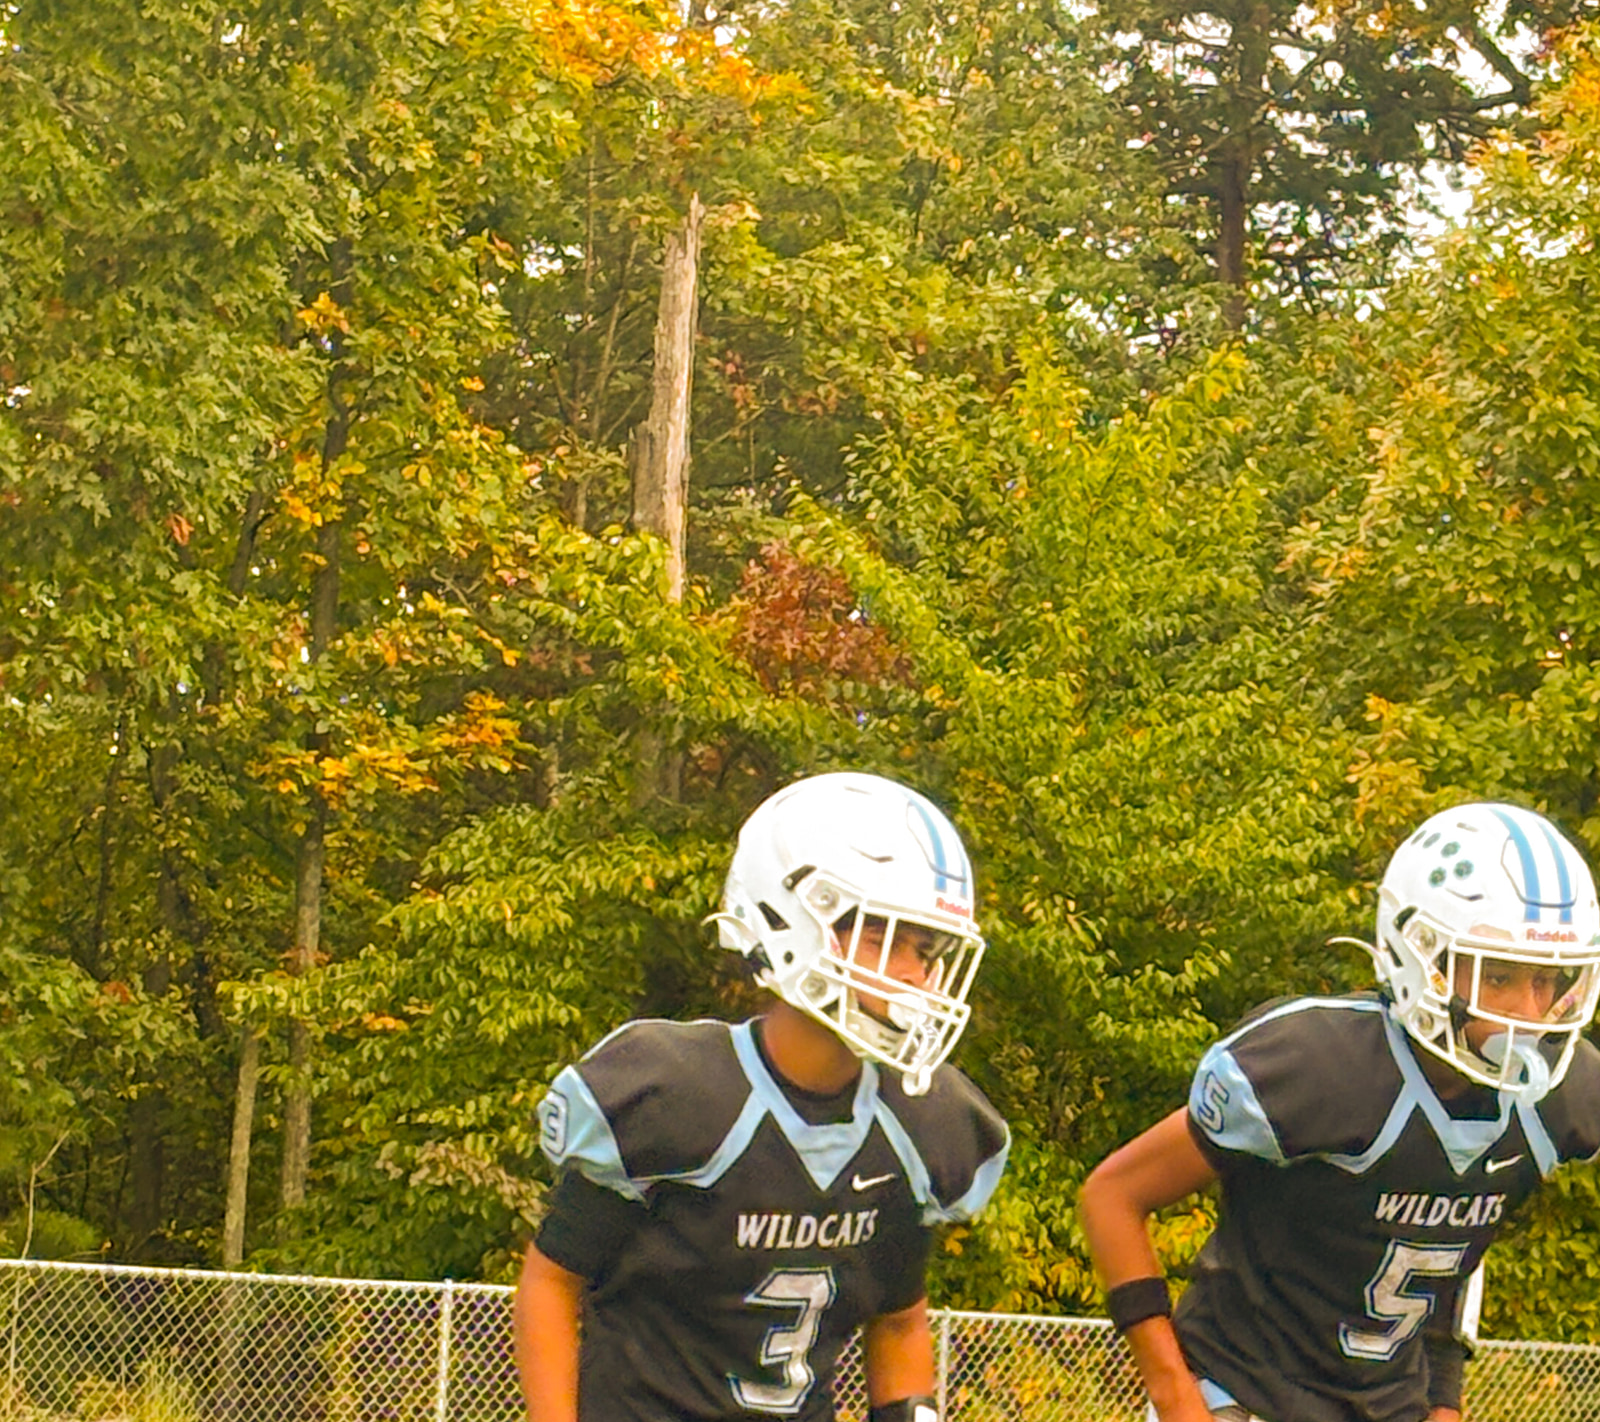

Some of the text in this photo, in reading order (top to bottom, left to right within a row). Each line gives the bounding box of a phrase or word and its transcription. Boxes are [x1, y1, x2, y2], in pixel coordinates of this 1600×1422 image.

[541, 1088, 569, 1157] 3
[1197, 1070, 1230, 1135] 5
[737, 1208, 879, 1249] WILDCATS
[1375, 1193, 1506, 1227] WILDCATS
[1338, 1238, 1471, 1361] 5
[726, 1266, 838, 1414] 3
